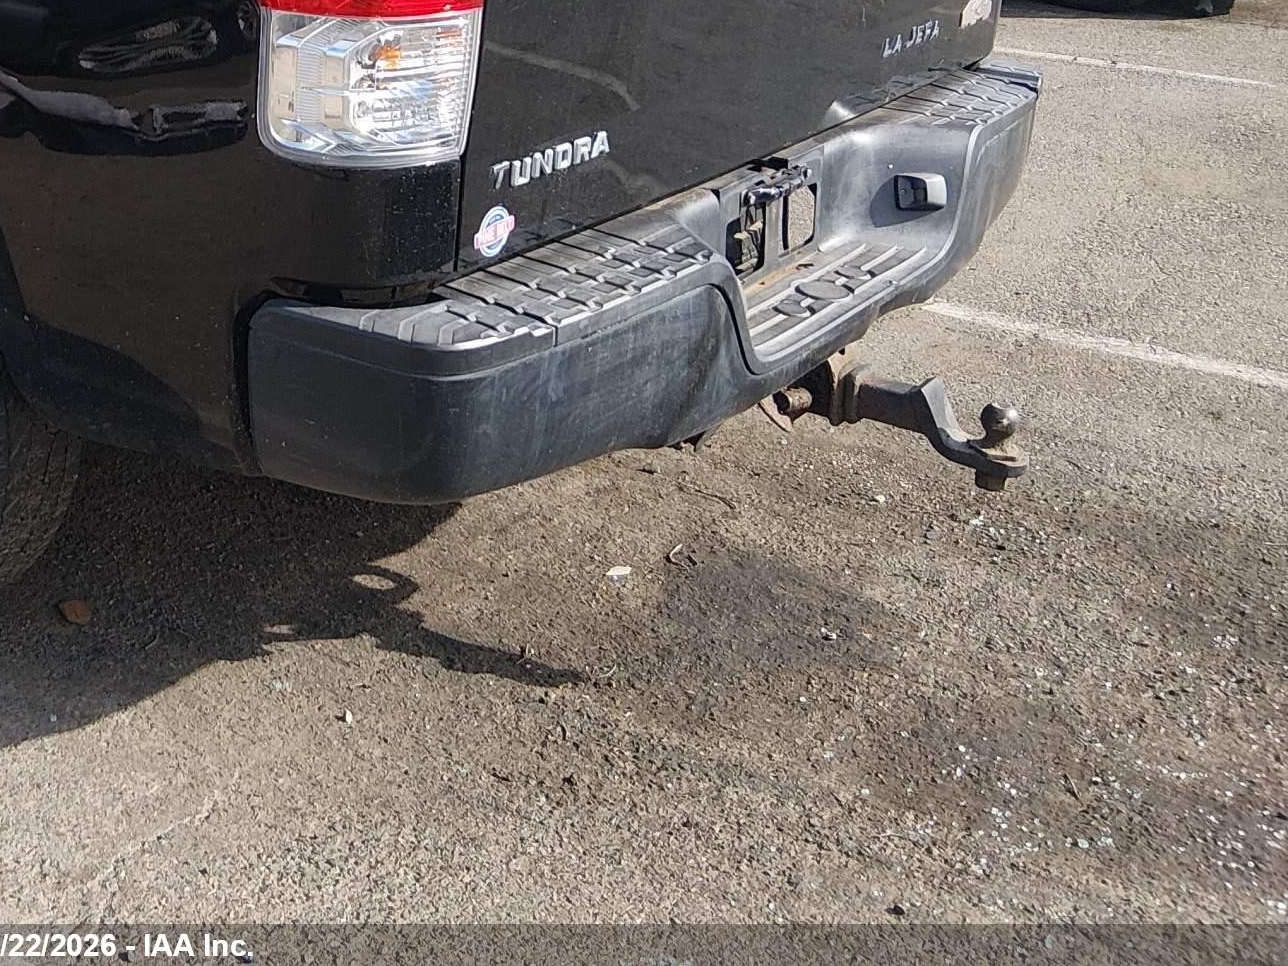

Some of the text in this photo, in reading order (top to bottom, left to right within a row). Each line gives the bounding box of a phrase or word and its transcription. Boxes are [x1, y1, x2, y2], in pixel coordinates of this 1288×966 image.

[882, 19, 940, 58] LA JEFA
[489, 130, 610, 190] TUNDRA
